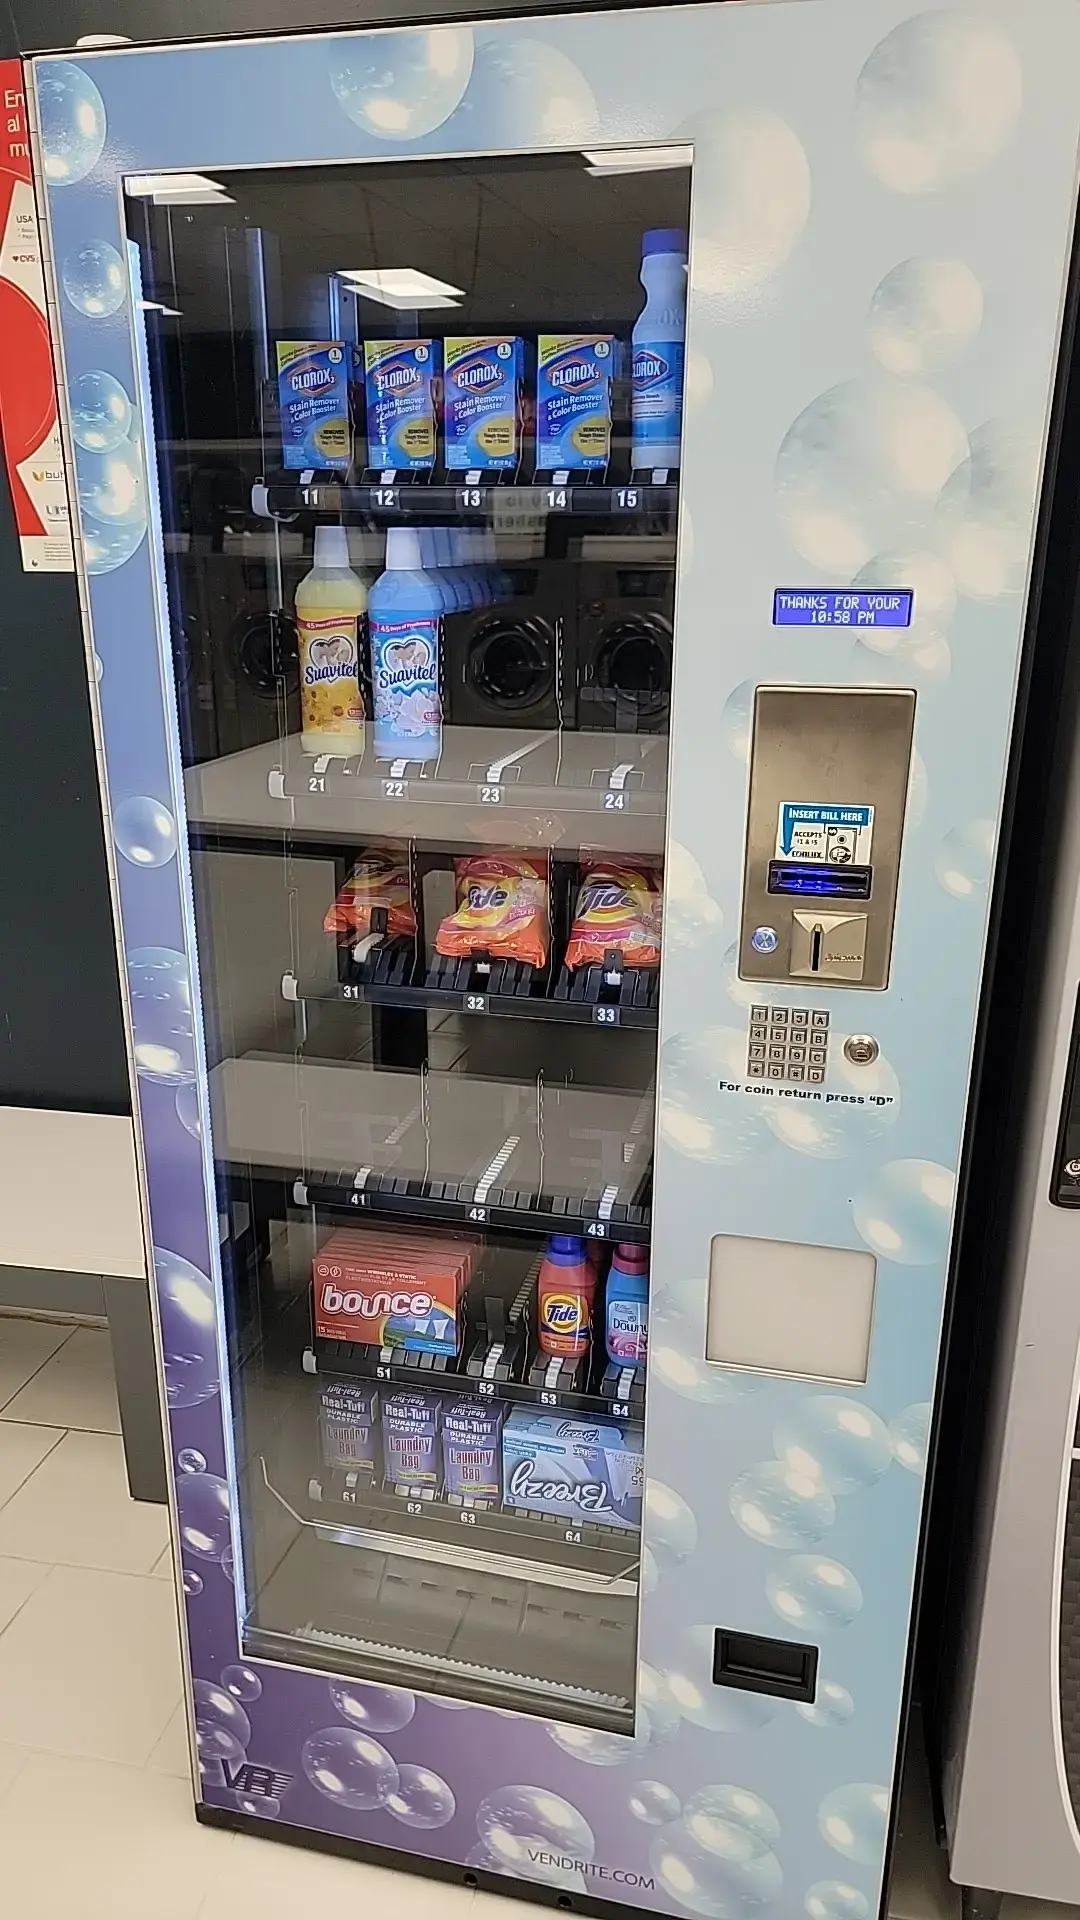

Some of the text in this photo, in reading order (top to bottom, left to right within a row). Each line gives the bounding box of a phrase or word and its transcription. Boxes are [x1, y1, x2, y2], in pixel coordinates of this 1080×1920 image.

[16, 215, 33, 223] USA
[632, 360, 661, 378] LOROX
[289, 398, 340, 413] Stain Remover
[375, 397, 425, 413] Stain Remover
[397, 404, 422, 415] Booster
[454, 395, 507, 412] Stain Remover
[547, 394, 604, 411] Stain Remover
[552, 407, 571, 419] Color
[571, 401, 599, 412] Booster
[294, 409, 312, 421] Color
[311, 405, 337, 415] Booster
[458, 408, 476, 419] Color
[476, 402, 503, 413] Booster
[302, 488, 319, 505] 11
[375, 489, 394, 506] 12
[461, 490, 481, 507] 13
[547, 490, 567, 507] 14
[617, 490, 637, 507] 15
[779, 596, 900, 610] THANKS FOR YOUR
[811, 610, 875, 624] 10:58 PM
[380, 625, 390, 633] 45
[305, 661, 358, 685] Suavitel
[379, 663, 436, 689] Suavitel
[308, 778, 326, 792] 21
[385, 783, 404, 797] 22
[481, 788, 500, 803] 23
[604, 794, 624, 809] 24
[788, 807, 863, 822] INSERT BILL HERE
[577, 885, 639, 919] Tide
[343, 985, 359, 999] 31
[467, 996, 485, 1010] 32
[597, 1008, 615, 1022] 33
[719, 1080, 741, 1092] For
[744, 1085, 774, 1096] coin
[778, 1089, 822, 1100] return
[825, 1094, 865, 1104] press
[351, 1193, 366, 1206] 41
[469, 1208, 486, 1221] 42
[588, 1223, 605, 1237] 43
[322, 1283, 433, 1319] bounce
[546, 1303, 578, 1323] Tide
[376, 1366, 391, 1379] 51
[479, 1382, 495, 1396] 52
[321, 1395, 366, 1413] Real-Tuff
[540, 1392, 557, 1406] 53
[326, 1408, 361, 1420] DURABLE
[385, 1403, 430, 1421] Real-Tuff
[612, 1403, 629, 1417] 54
[389, 1418, 426, 1429] DURABLE
[390, 1424, 423, 1433] PLASTIC
[445, 1417, 492, 1434] Real-Tuff
[326, 1425, 369, 1443] Laundry
[449, 1431, 487, 1441] DURABLE
[555, 1421, 600, 1443] Breezy
[388, 1435, 432, 1454] Laundry
[450, 1436, 484, 1446] PLASTIC
[339, 1442, 356, 1457] Bag
[449, 1447, 494, 1467] Laundry
[401, 1453, 419, 1469] Bag
[462, 1466, 480, 1481] Bag
[510, 1458, 613, 1513] Breezy
[342, 1491, 356, 1503] 61
[407, 1502, 422, 1514] 62
[460, 1512, 476, 1524] 63
[565, 1530, 581, 1543] 64
[527, 1848, 656, 1890] VENDRITE.COM
